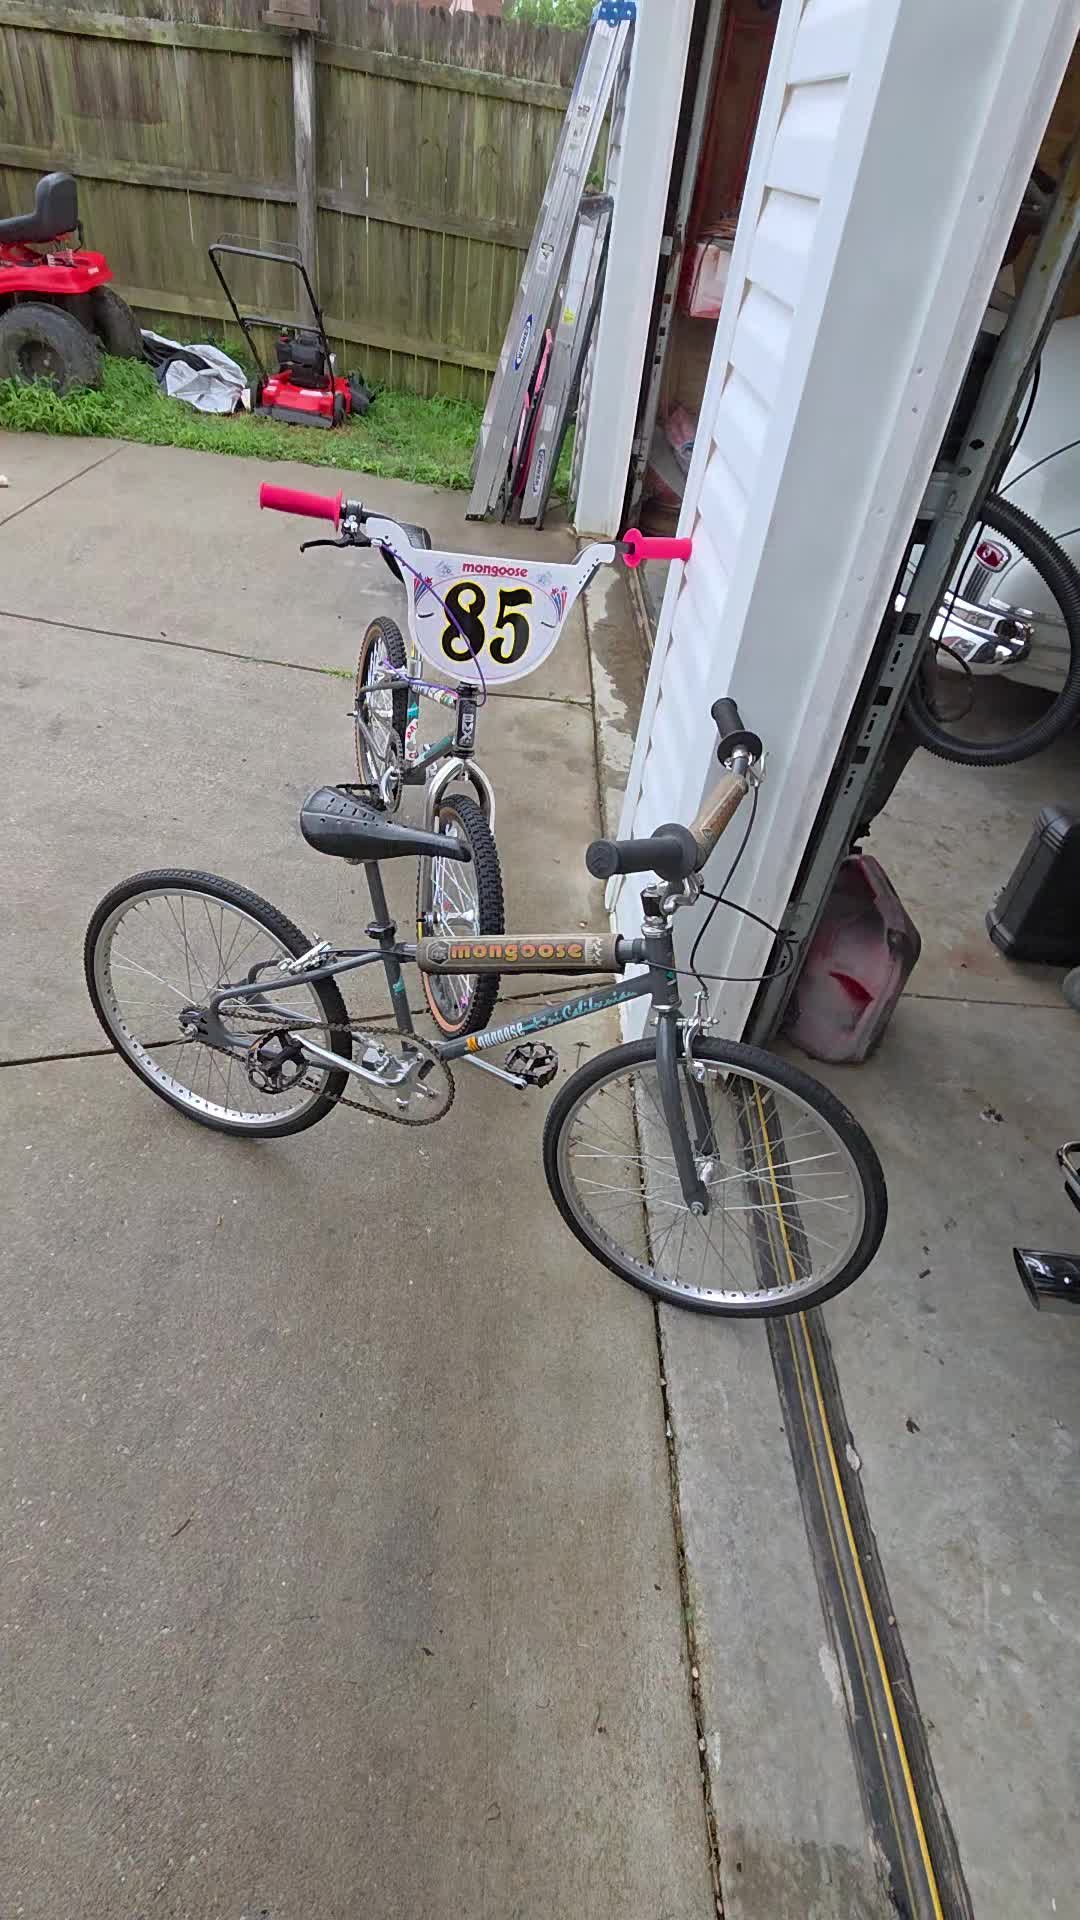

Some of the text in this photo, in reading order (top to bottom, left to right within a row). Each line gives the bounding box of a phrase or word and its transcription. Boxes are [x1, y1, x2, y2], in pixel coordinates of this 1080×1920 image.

[462, 562, 529, 578] mongoose
[441, 580, 534, 665] 85
[450, 942, 583, 962] mongoose
